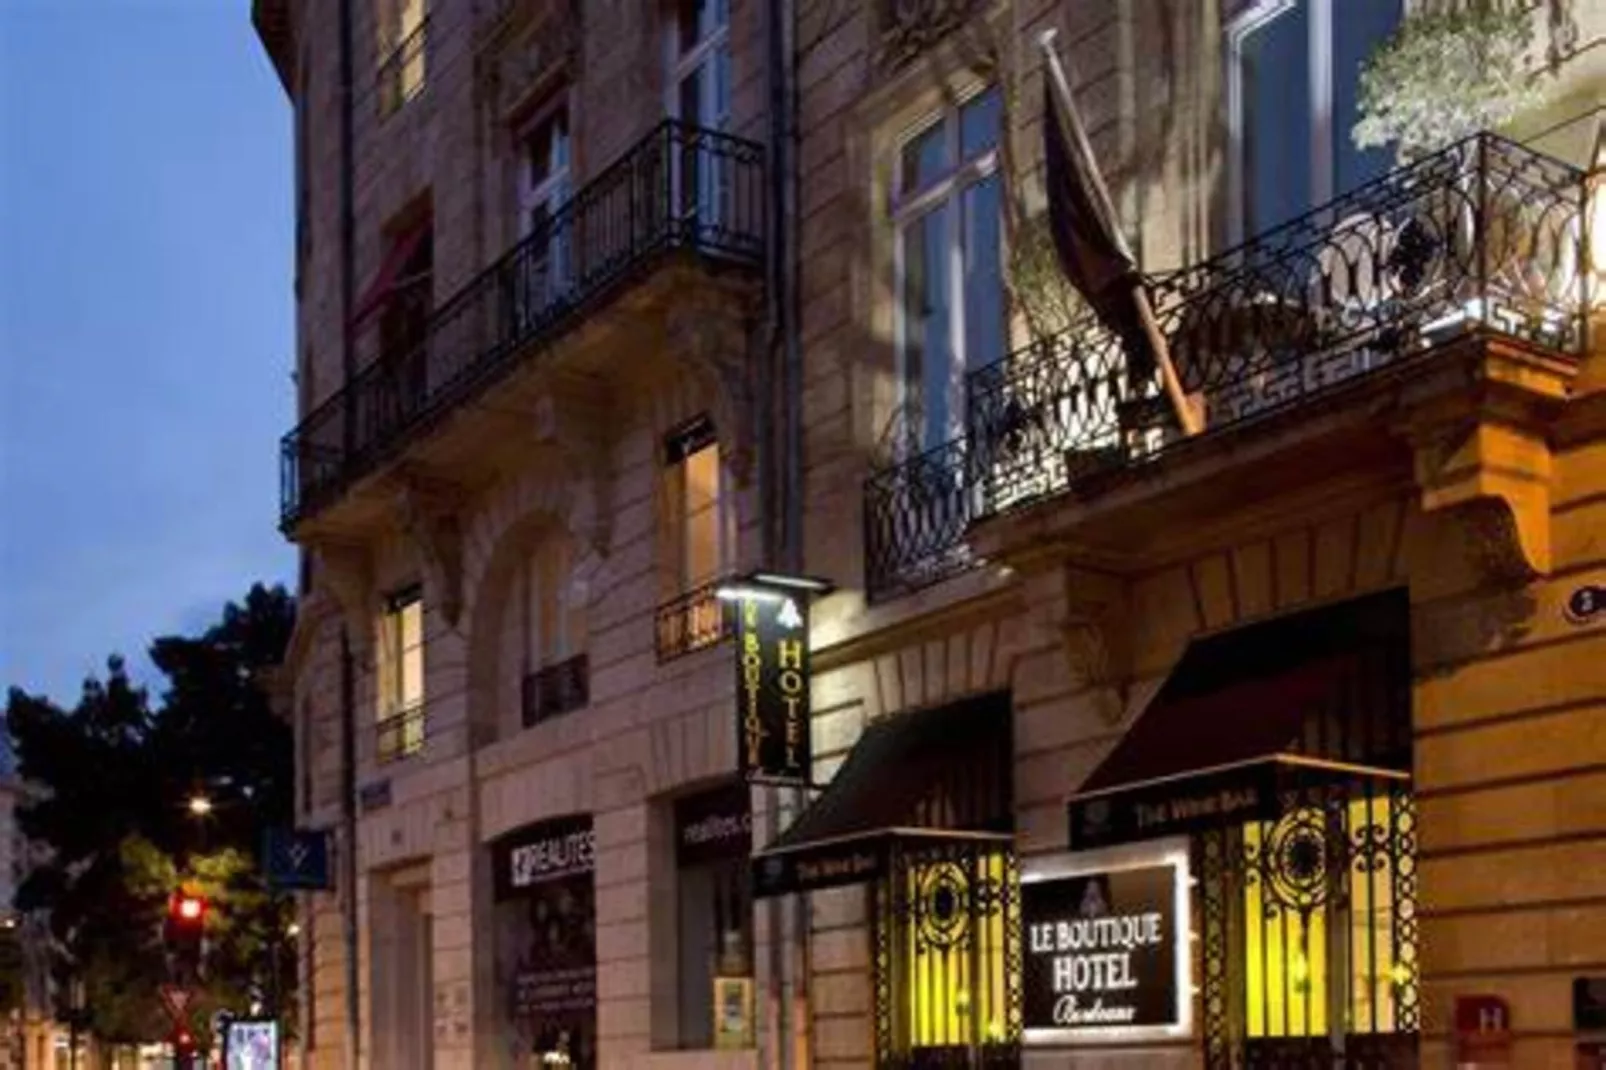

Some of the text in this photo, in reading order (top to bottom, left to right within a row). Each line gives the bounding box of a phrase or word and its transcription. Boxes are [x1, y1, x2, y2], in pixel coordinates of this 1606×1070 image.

[777, 638, 803, 769] HOTEL
[1030, 913, 1162, 952] LE BOUTIQUE
[1053, 952, 1138, 992] HOTEL
[1052, 994, 1137, 1025] Bordeaux
